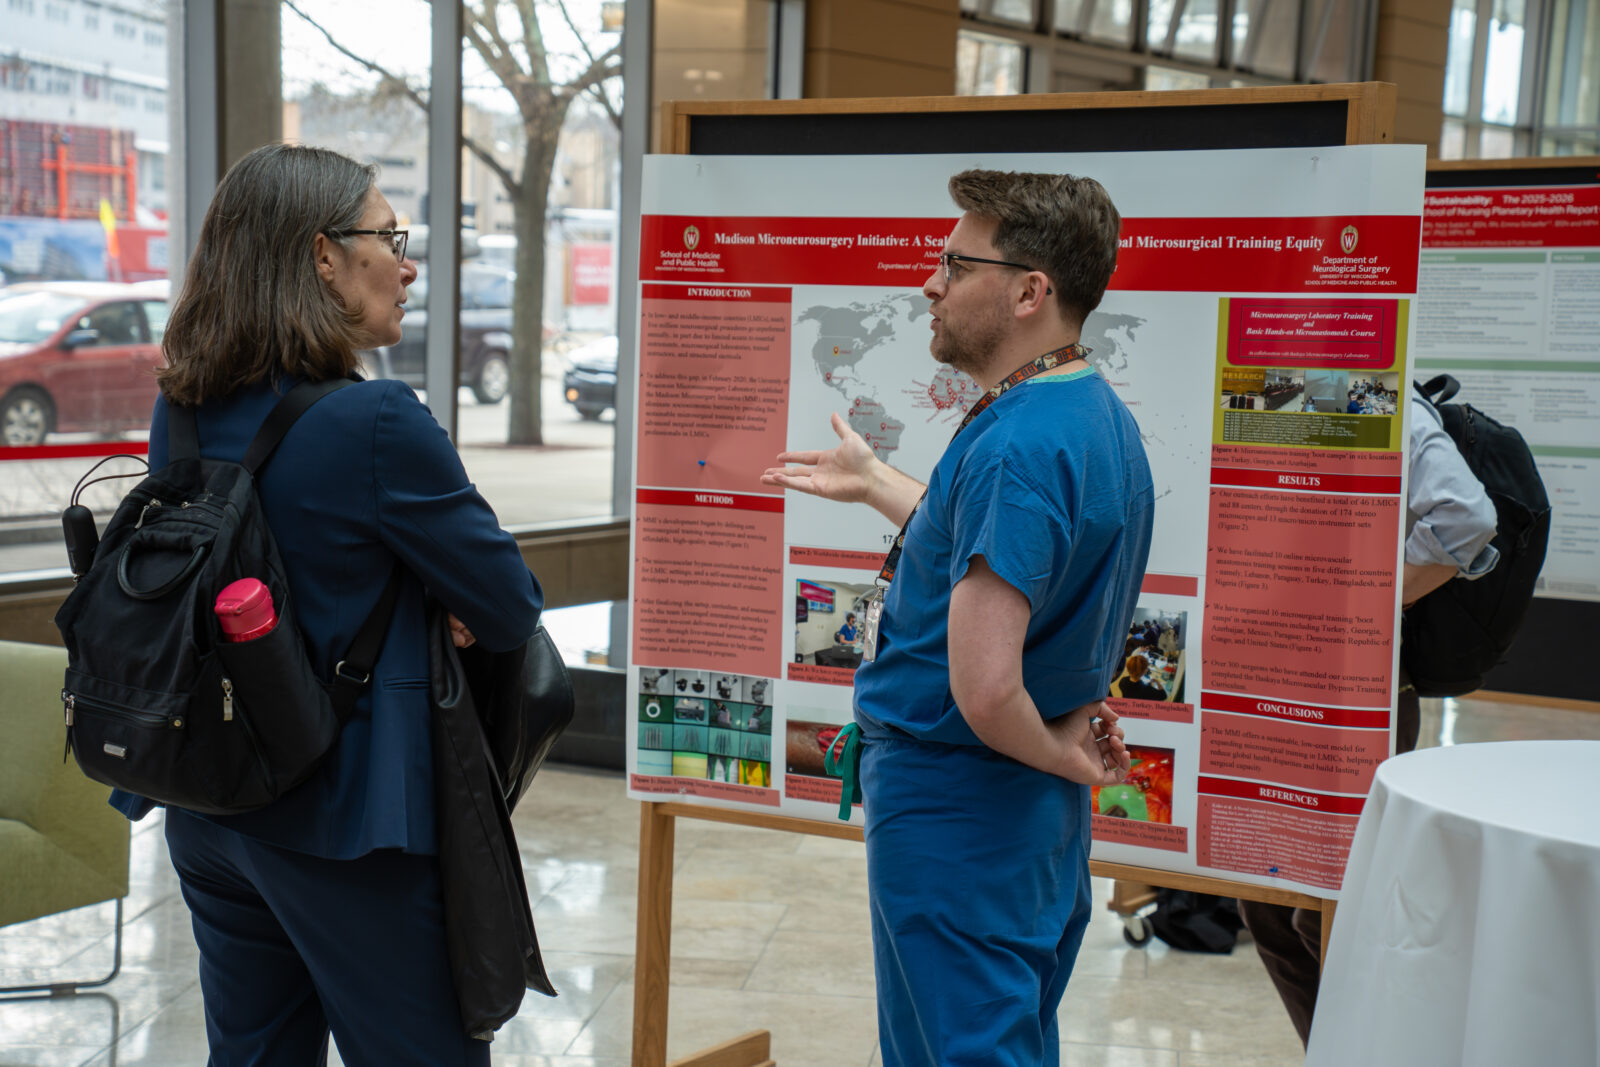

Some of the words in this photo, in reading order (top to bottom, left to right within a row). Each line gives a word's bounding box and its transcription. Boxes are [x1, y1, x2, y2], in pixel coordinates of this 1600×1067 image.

[1503, 195, 1518, 204] The
[1458, 208, 1490, 218] Nursing
[1492, 207, 1532, 217] Planetary
[1535, 206, 1564, 214] Health
[1566, 205, 1598, 216] Report
[714, 232, 754, 244] Madison
[758, 232, 854, 248] Microneurosurgery
[857, 234, 909, 247] Initiative:
[912, 235, 921, 246] A
[924, 235, 948, 247] Scal
[1136, 236, 1222, 251] Microsurgical
[1226, 236, 1282, 251] Training
[1286, 236, 1324, 252] Equity
[1323, 256, 1366, 265] Department
[1312, 265, 1356, 273] Neurological
[1358, 265, 1390, 274] Surgery
[688, 288, 752, 297] INTRODUCTION
[1251, 311, 1307, 320] Microneurosurgery
[1308, 312, 1341, 320] Laboratory
[1343, 312, 1373, 321] Training
[1278, 475, 1320, 486] RESULTS
[695, 495, 734, 504] METHODS
[1300, 507, 1328, 516] donation
[1327, 566, 1357, 575] different
[1326, 615, 1353, 624] training
[1307, 634, 1345, 644] Democratic
[1348, 638, 1380, 646] Republic
[1356, 686, 1386, 694] Training
[1257, 702, 1324, 719] CONCLUSIONS
[1302, 739, 1328, 749] low-cost
[1347, 756, 1373, 765] helping
[1260, 787, 1319, 806] REFERENCES
